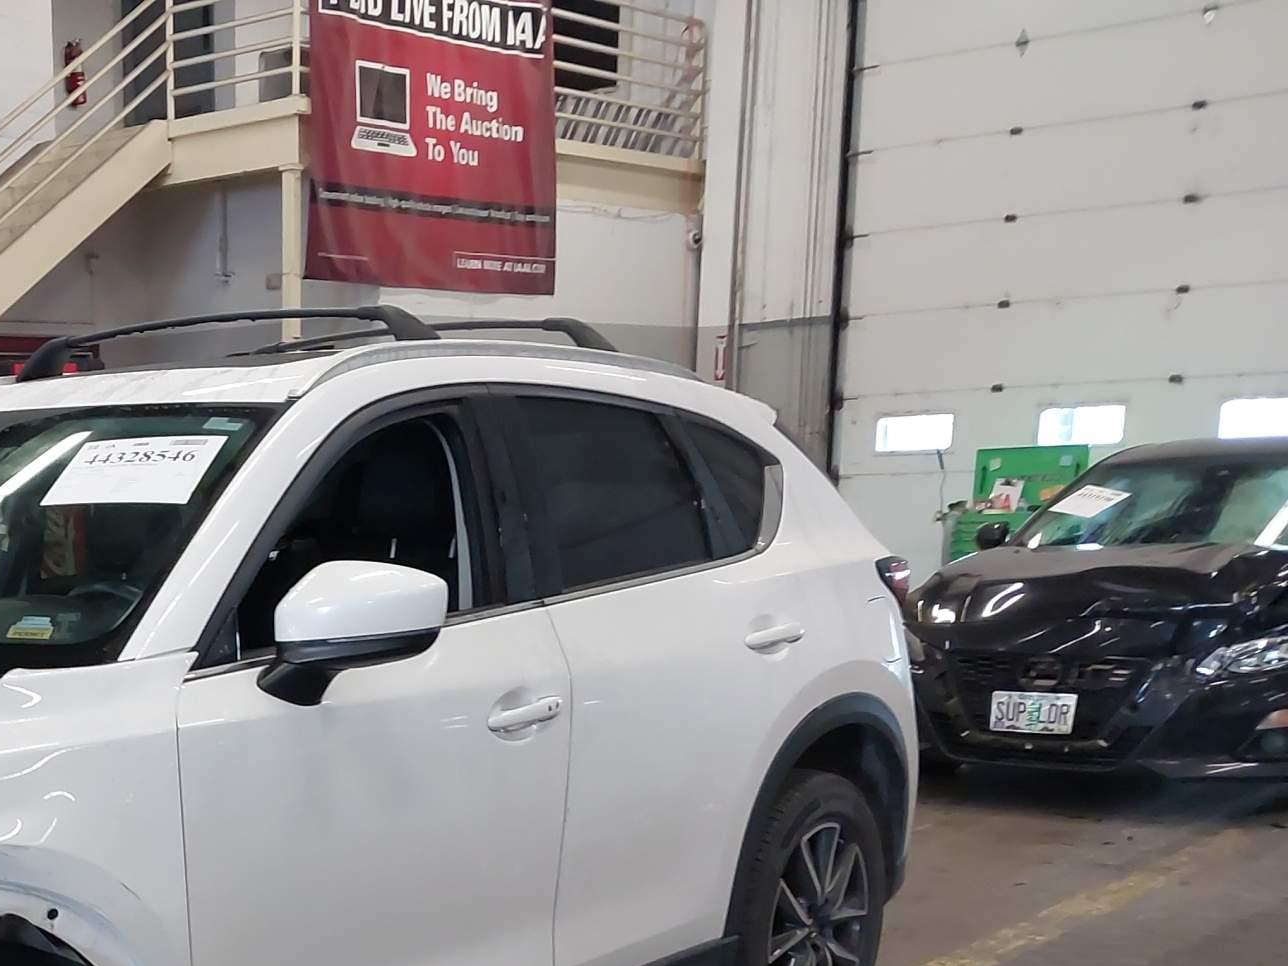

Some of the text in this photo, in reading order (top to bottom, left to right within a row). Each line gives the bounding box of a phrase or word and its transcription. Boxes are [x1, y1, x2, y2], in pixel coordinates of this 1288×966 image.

[390, 0, 436, 29] LIVE
[442, 0, 500, 43] FROM
[426, 72, 498, 112] We Bring
[425, 106, 524, 142] The Auction
[425, 137, 479, 166] To You
[84, 450, 196, 465] 44328546
[995, 700, 1026, 722] SUP
